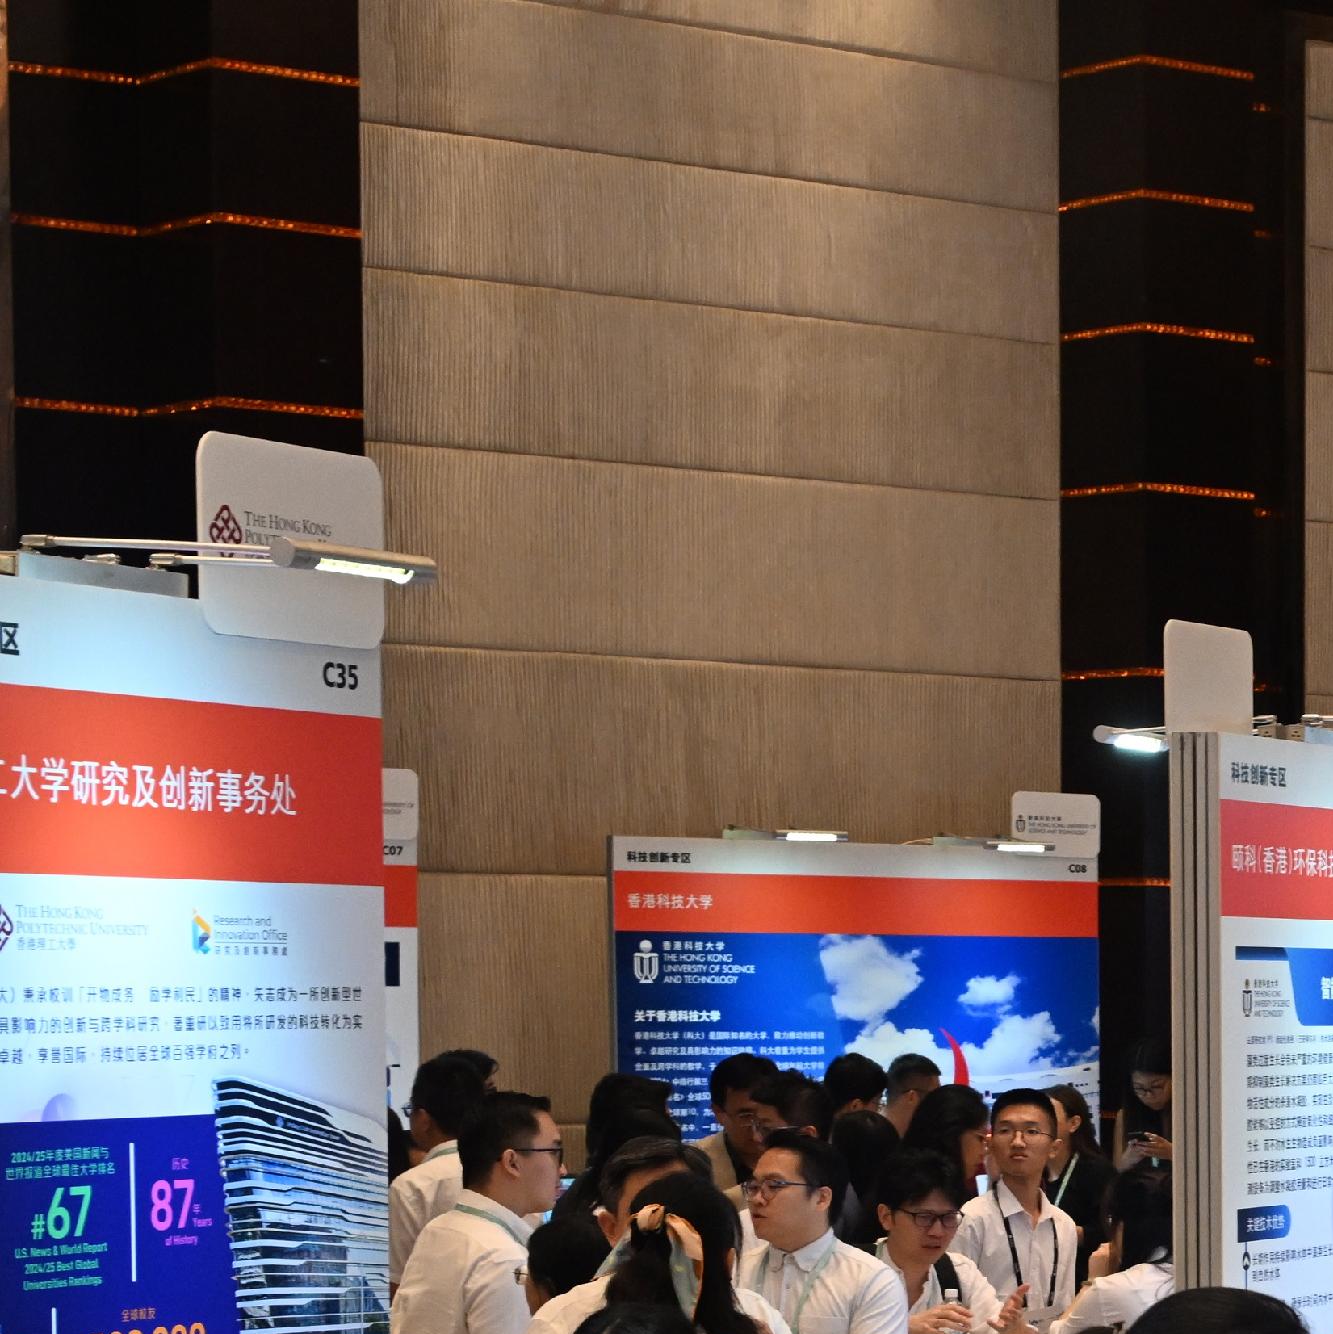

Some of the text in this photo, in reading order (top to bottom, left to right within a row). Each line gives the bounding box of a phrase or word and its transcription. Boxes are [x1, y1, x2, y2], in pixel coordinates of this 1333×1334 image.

[243, 510, 267, 528] THE
[269, 514, 301, 533] HONG
[302, 519, 332, 537] KONG
[322, 660, 359, 690] C35
[1231, 761, 1287, 788] 科技创新专区
[628, 892, 714, 910] 香港科技大学
[663, 953, 733, 964] THE HONG KONG
[31, 1185, 92, 1240] #67
[151, 1179, 195, 1232] 87
